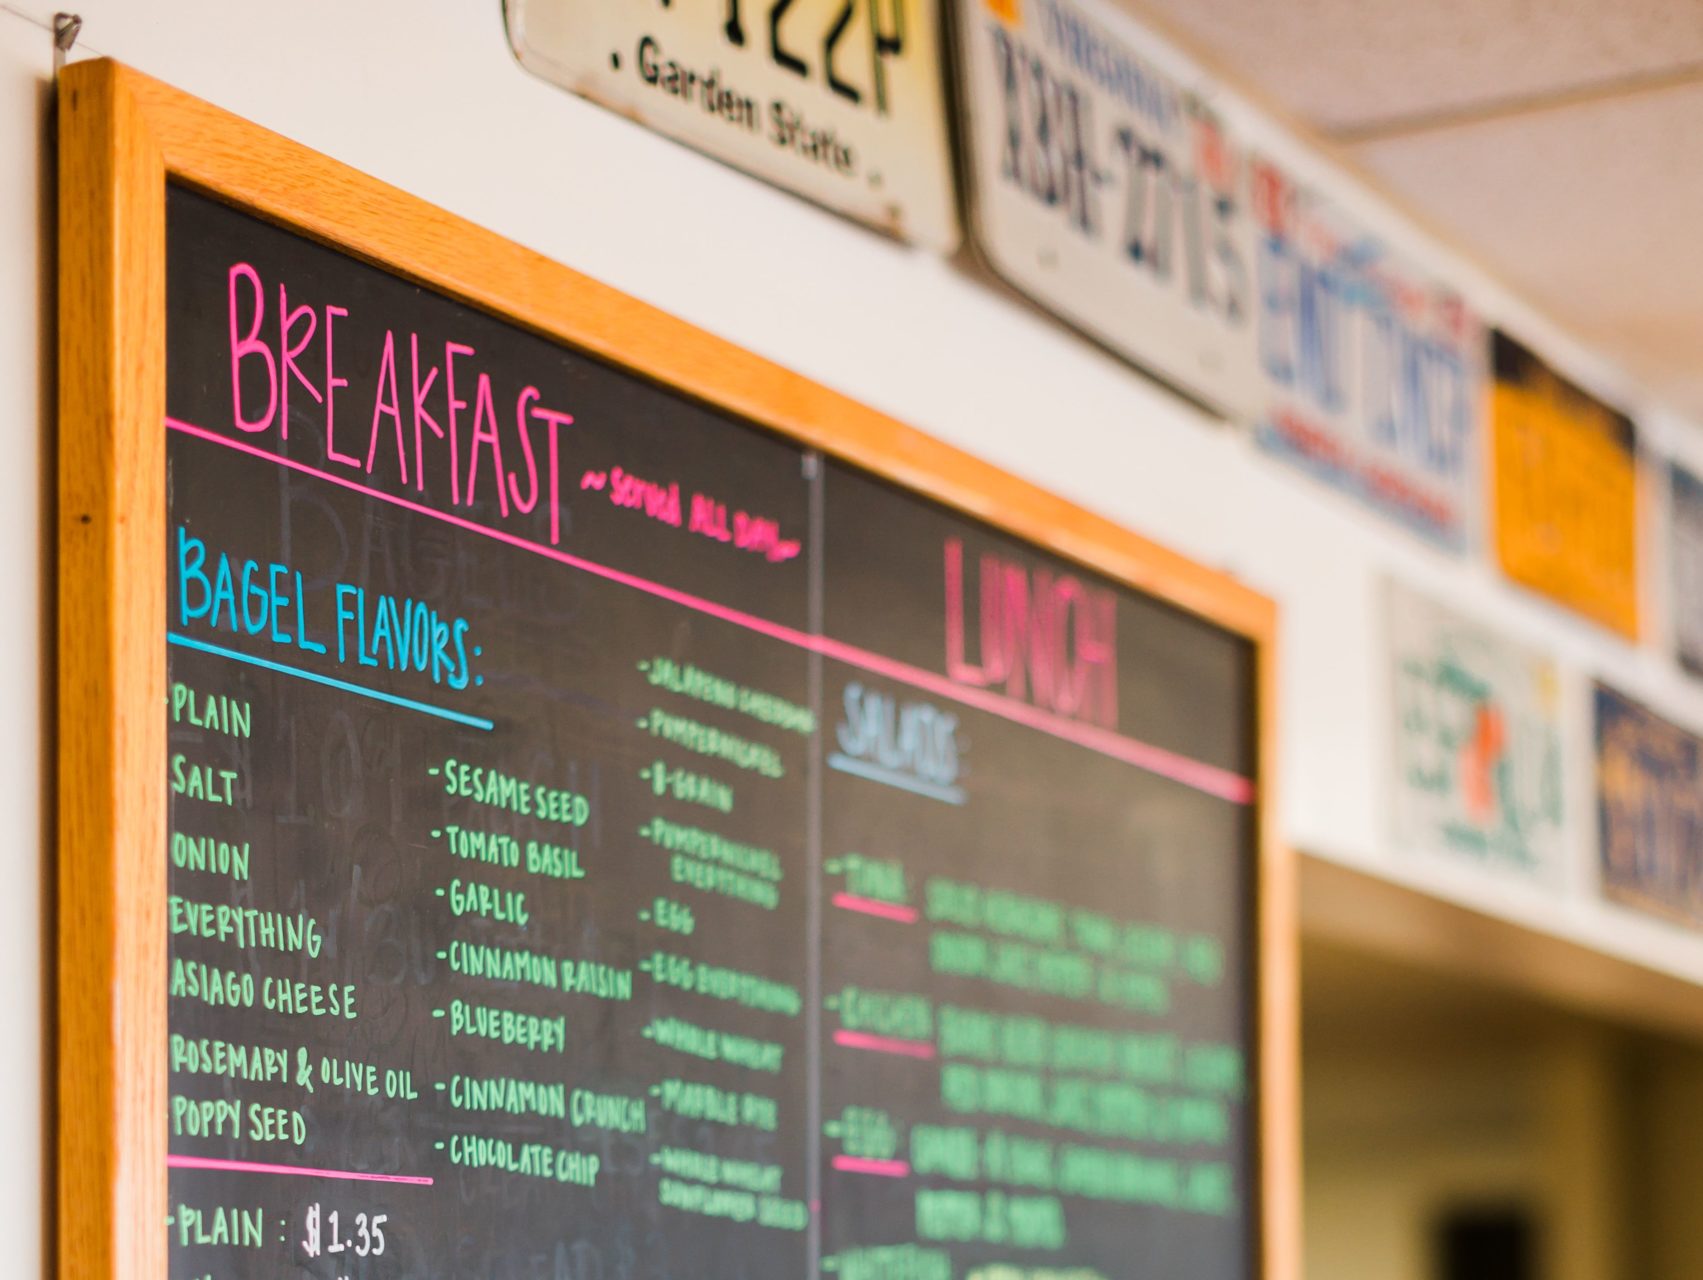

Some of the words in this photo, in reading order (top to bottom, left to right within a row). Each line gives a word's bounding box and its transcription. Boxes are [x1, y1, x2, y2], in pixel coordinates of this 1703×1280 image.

[638, 36, 759, 130] Garden
[767, 102, 855, 173] State
[229, 262, 574, 545] BREAKFAST
[177, 526, 326, 655] BAGEL
[336, 583, 483, 690] FLAVORS:
[944, 537, 1117, 731] LUNCH
[172, 683, 251, 738] PLAIN
[171, 754, 238, 806] SALT
[445, 759, 531, 816] SESAME
[534, 785, 589, 827] SEED
[171, 832, 249, 880] ONION
[445, 825, 520, 867] TOMATO
[526, 841, 585, 879] BASIL
[169, 896, 322, 958] EVERYTHING
[450, 878, 529, 926] GARLIC
[171, 958, 254, 1007] ASIAGO
[263, 977, 357, 1019] CHEESE
[450, 940, 557, 989] CINNAMON
[560, 959, 632, 1000] RAISIN
[450, 999, 565, 1054] BLUEBERRY
[170, 1033, 288, 1083] ROSEMARY
[296, 1047, 314, 1093] &
[321, 1057, 379, 1096] OLIVE
[386, 1069, 418, 1100] OIL
[171, 1095, 241, 1139] POPPY
[249, 1103, 306, 1145] SEED
[450, 1074, 565, 1119] CINNAMON
[569, 1088, 646, 1134] CRUNCH
[450, 1135, 554, 1178] CHOCOLATE
[555, 1150, 600, 1187] CHIP
[302, 1202, 388, 1257] $1.35
